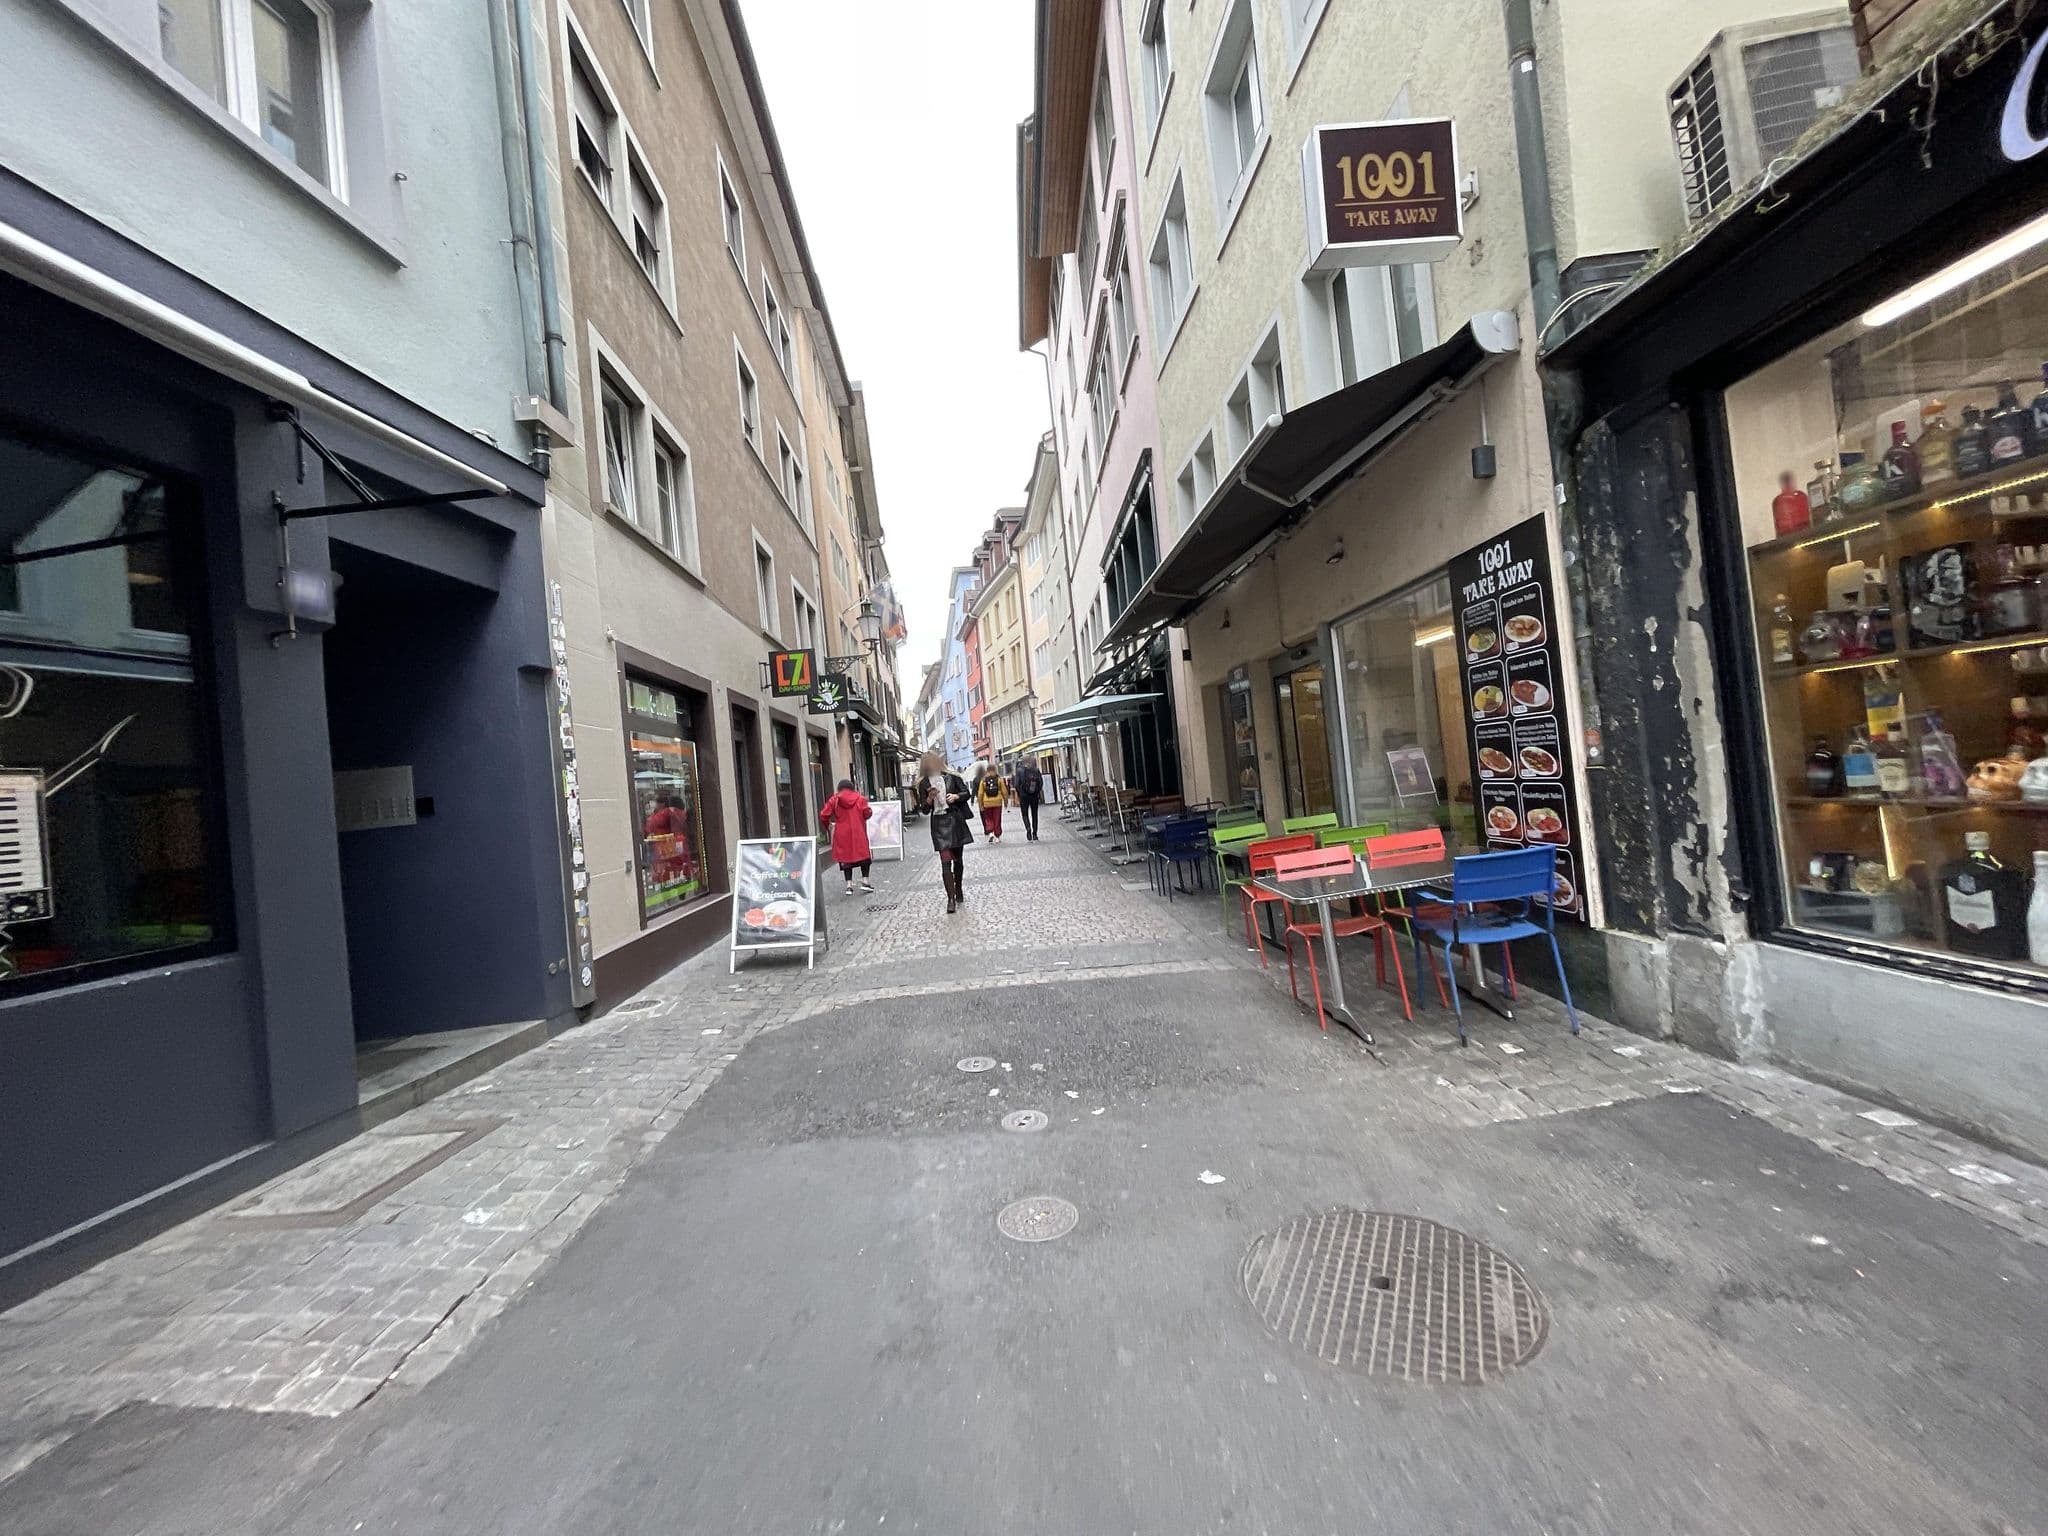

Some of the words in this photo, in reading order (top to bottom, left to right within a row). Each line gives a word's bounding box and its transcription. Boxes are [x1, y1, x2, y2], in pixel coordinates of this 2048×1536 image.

[1336, 151, 1436, 200] 1001
[1345, 210, 1390, 227] TAKE
[1394, 207, 1438, 224] AWAY
[1478, 540, 1512, 575] 1001
[1462, 575, 1496, 603] TAKE
[1497, 558, 1533, 590] AWAY
